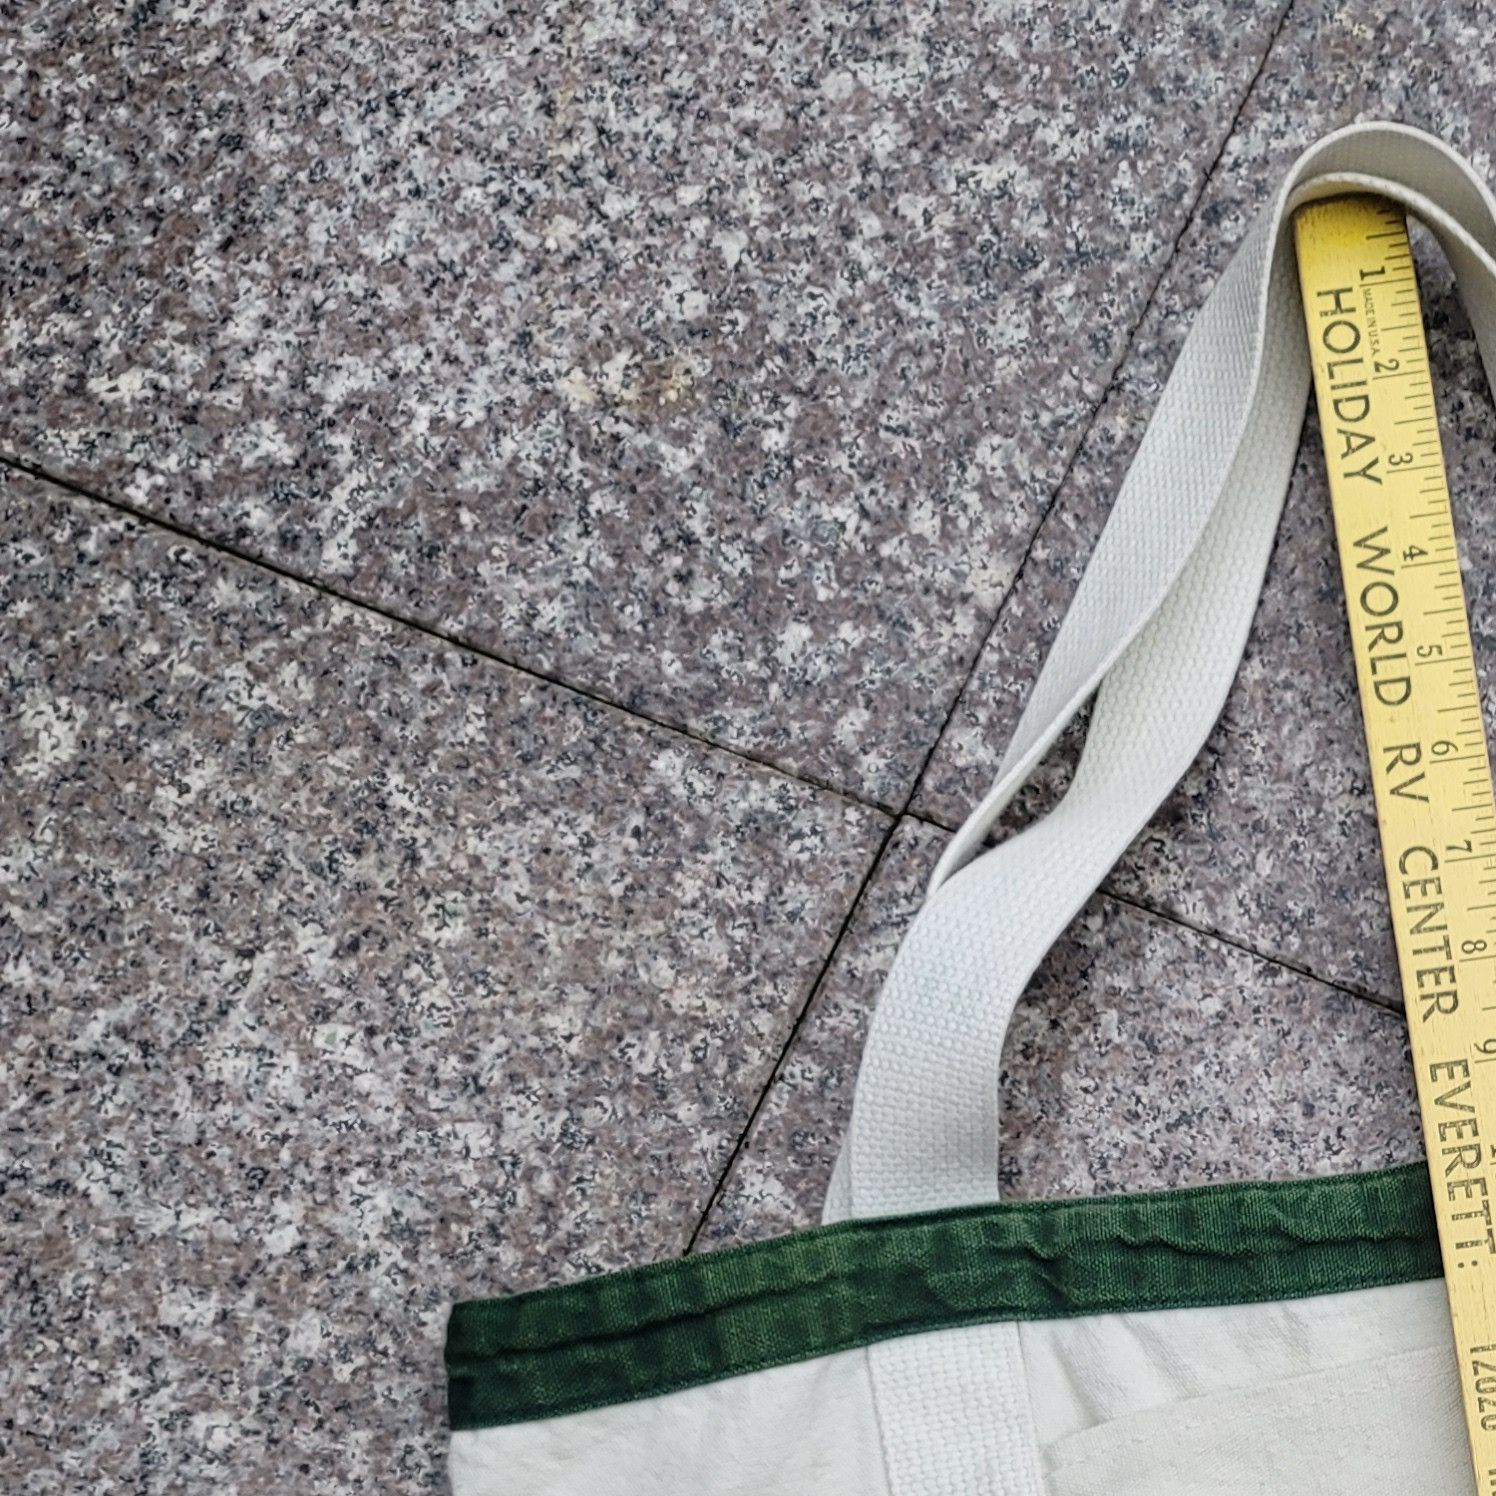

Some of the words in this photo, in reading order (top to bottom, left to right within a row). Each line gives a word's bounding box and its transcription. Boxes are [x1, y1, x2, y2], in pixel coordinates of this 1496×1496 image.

[1317, 287, 1381, 483] HOLIDAY
[1353, 527, 1411, 706] WORLD
[1358, 265, 1386, 281] 1
[1372, 357, 1400, 373] 2
[1387, 451, 1414, 466] 3
[1401, 544, 1428, 561] 4
[1415, 643, 1443, 658] 5
[1430, 739, 1458, 756] 6
[1444, 838, 1473, 853] 7
[1460, 938, 1488, 955] 8
[1382, 741, 1429, 802] RV
[1398, 845, 1458, 1021] CENTER
[1429, 1059, 1496, 1267] EVERETT:
